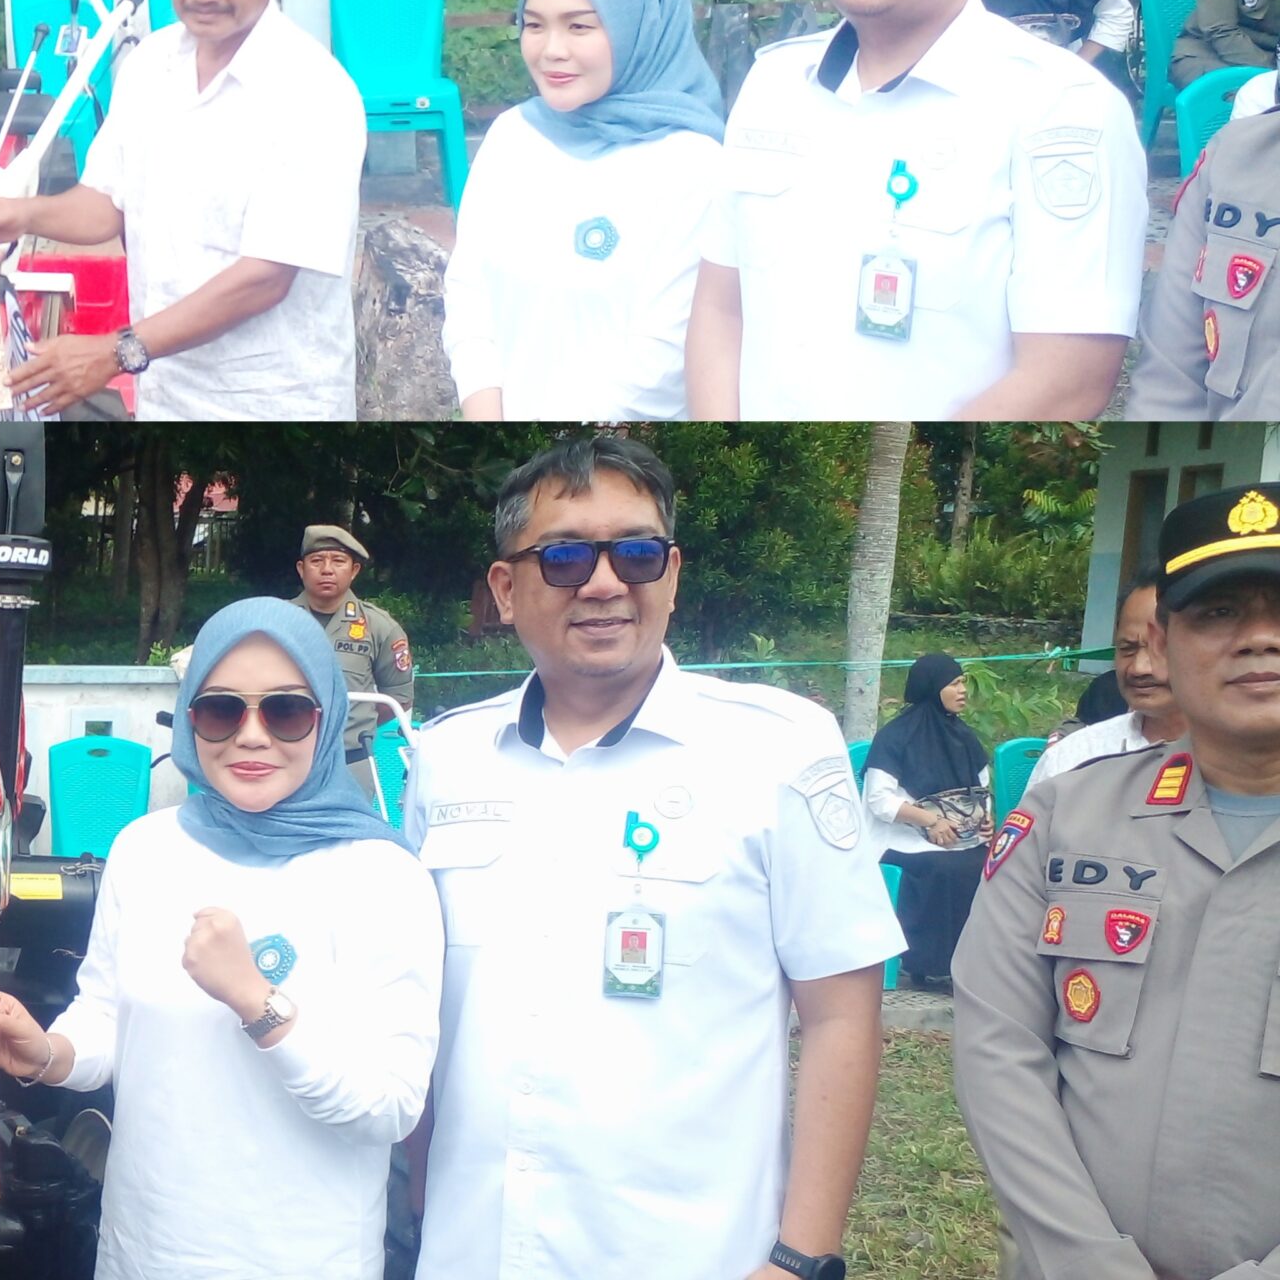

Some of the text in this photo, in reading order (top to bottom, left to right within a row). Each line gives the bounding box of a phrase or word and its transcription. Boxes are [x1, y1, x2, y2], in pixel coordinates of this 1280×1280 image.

[337, 642, 369, 653] POL PP
[1048, 857, 1158, 891] EDY
